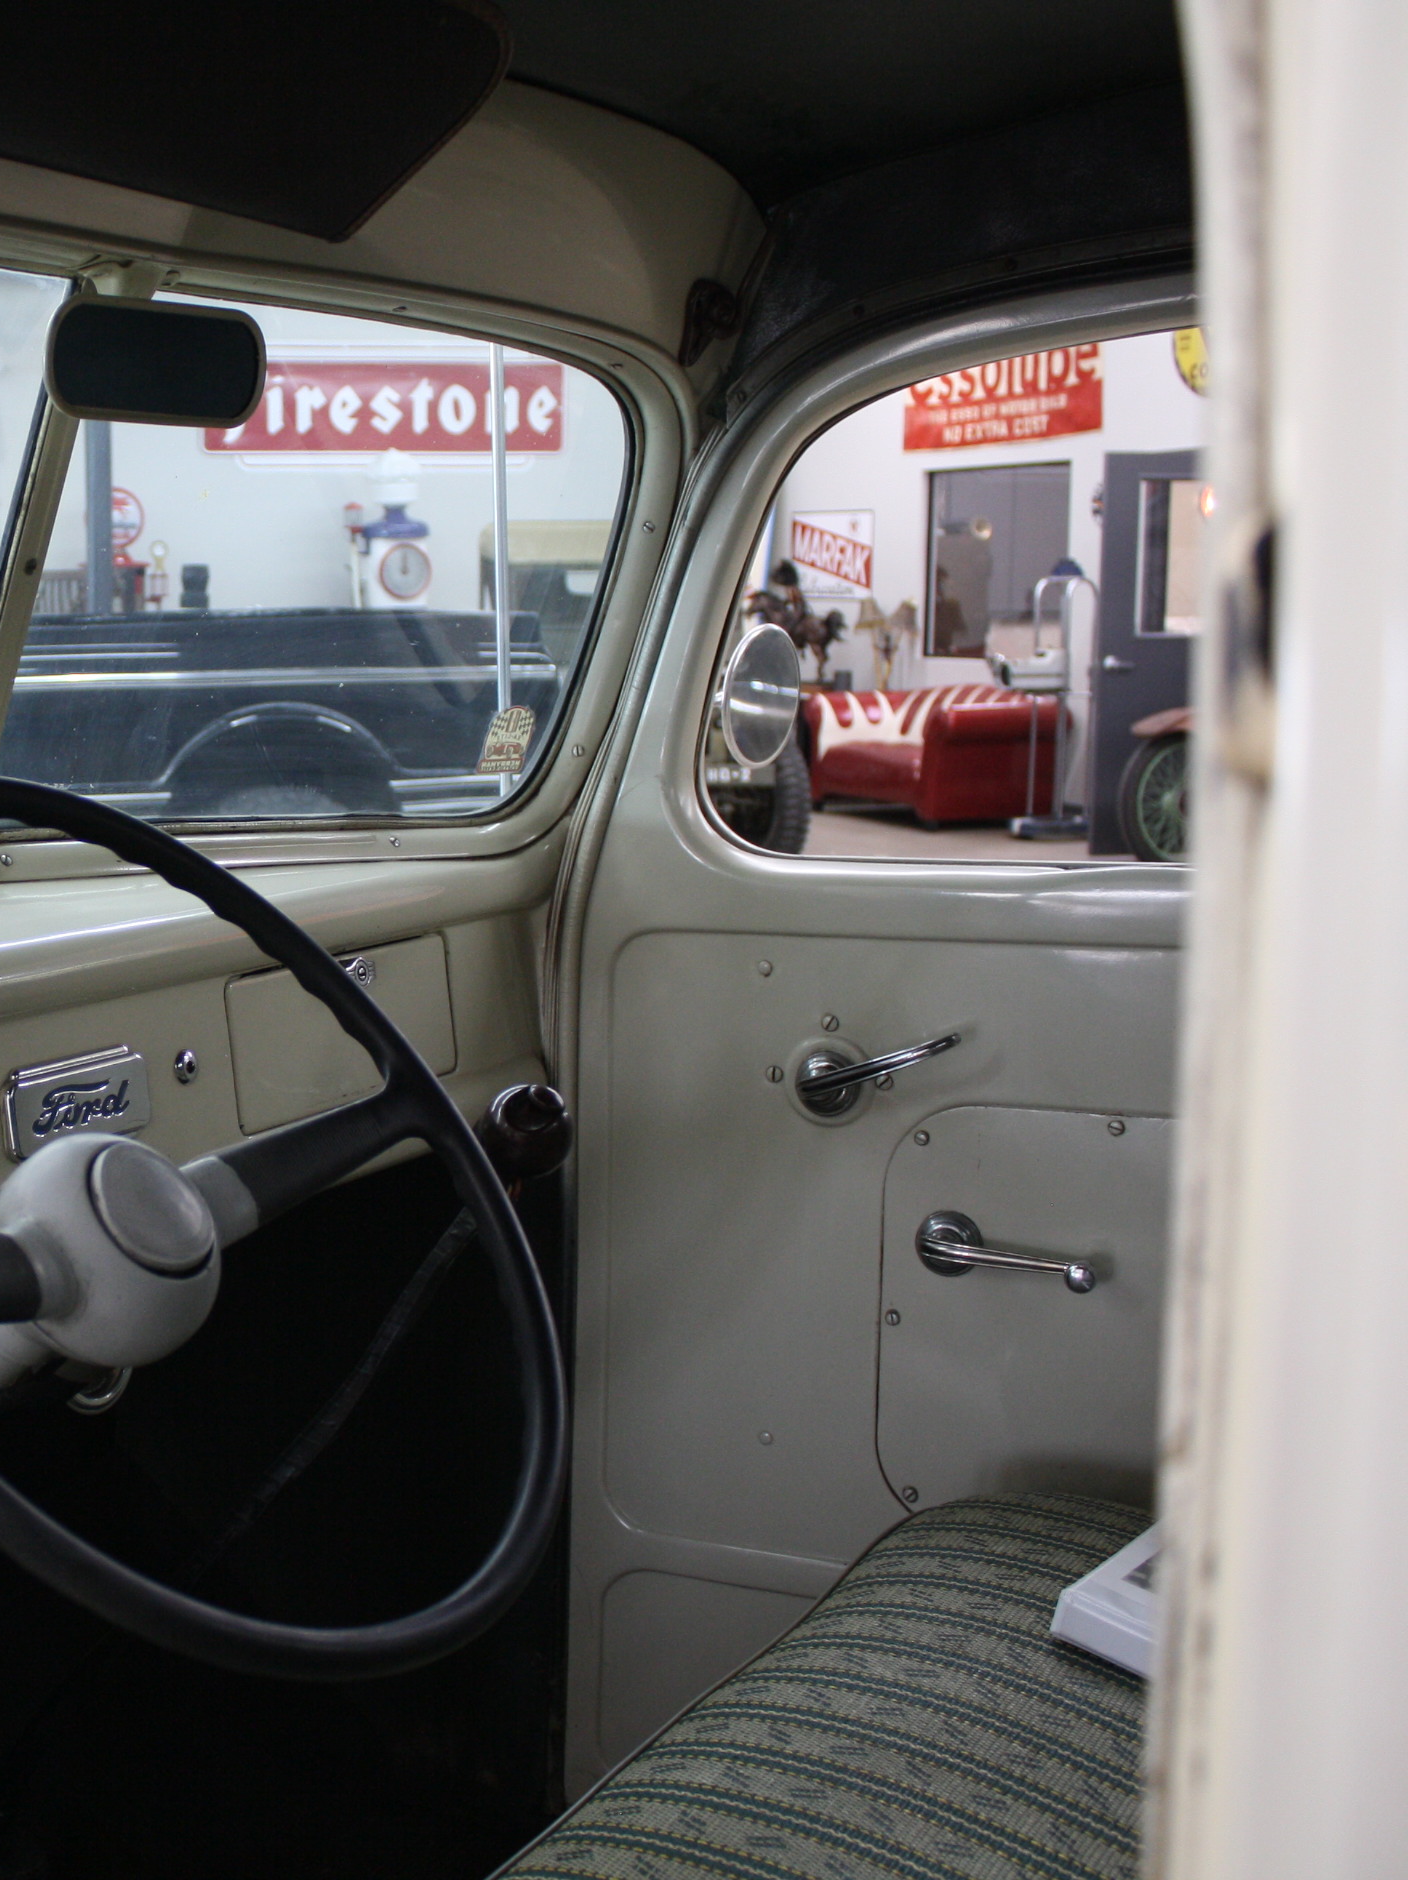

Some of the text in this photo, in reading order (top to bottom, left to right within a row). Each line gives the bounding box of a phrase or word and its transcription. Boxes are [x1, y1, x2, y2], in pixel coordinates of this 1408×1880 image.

[222, 375, 559, 444] irestone
[943, 415, 1049, 444] NO EXTRA COST
[793, 523, 870, 586] MARFAK
[33, 1077, 130, 1138] Ford
